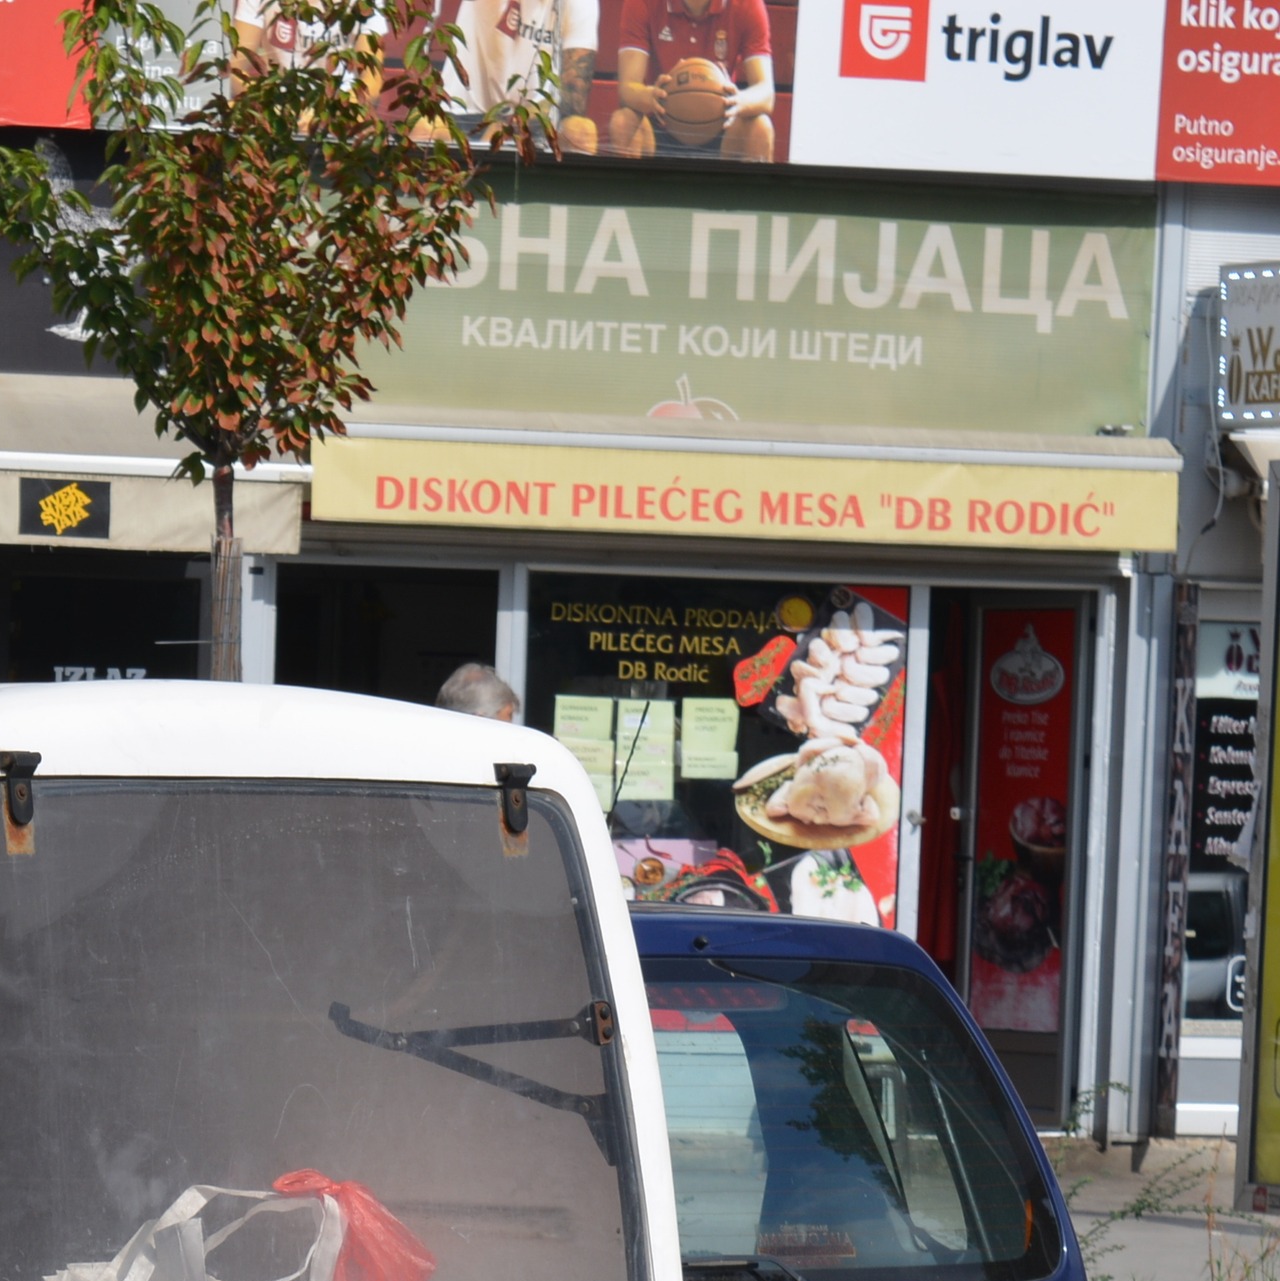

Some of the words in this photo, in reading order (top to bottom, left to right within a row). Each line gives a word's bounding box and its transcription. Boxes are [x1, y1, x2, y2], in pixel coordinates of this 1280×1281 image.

[1181, 0, 1236, 28] klik
[942, 12, 1114, 82] triglav
[1174, 112, 1234, 137] Putno
[688, 211, 1129, 333] ПИЈАЦА
[462, 317, 675, 354] КВАЛИТЕТ
[678, 319, 776, 359] КОЈИ
[789, 330, 923, 370] ШТЕДИ
[375, 475, 557, 517] DISKONT
[571, 475, 744, 524] PILEĆEG
[759, 492, 865, 529] MESA
[880, 492, 952, 533] "DB
[967, 488, 1116, 538] RODIĆ"
[550, 602, 678, 627] DISKONTNA
[684, 608, 783, 634] PRODAJA
[589, 630, 674, 654] PILEĆEG
[680, 635, 741, 656] MESA
[618, 660, 648, 680] DB
[653, 663, 709, 683] Rodić
